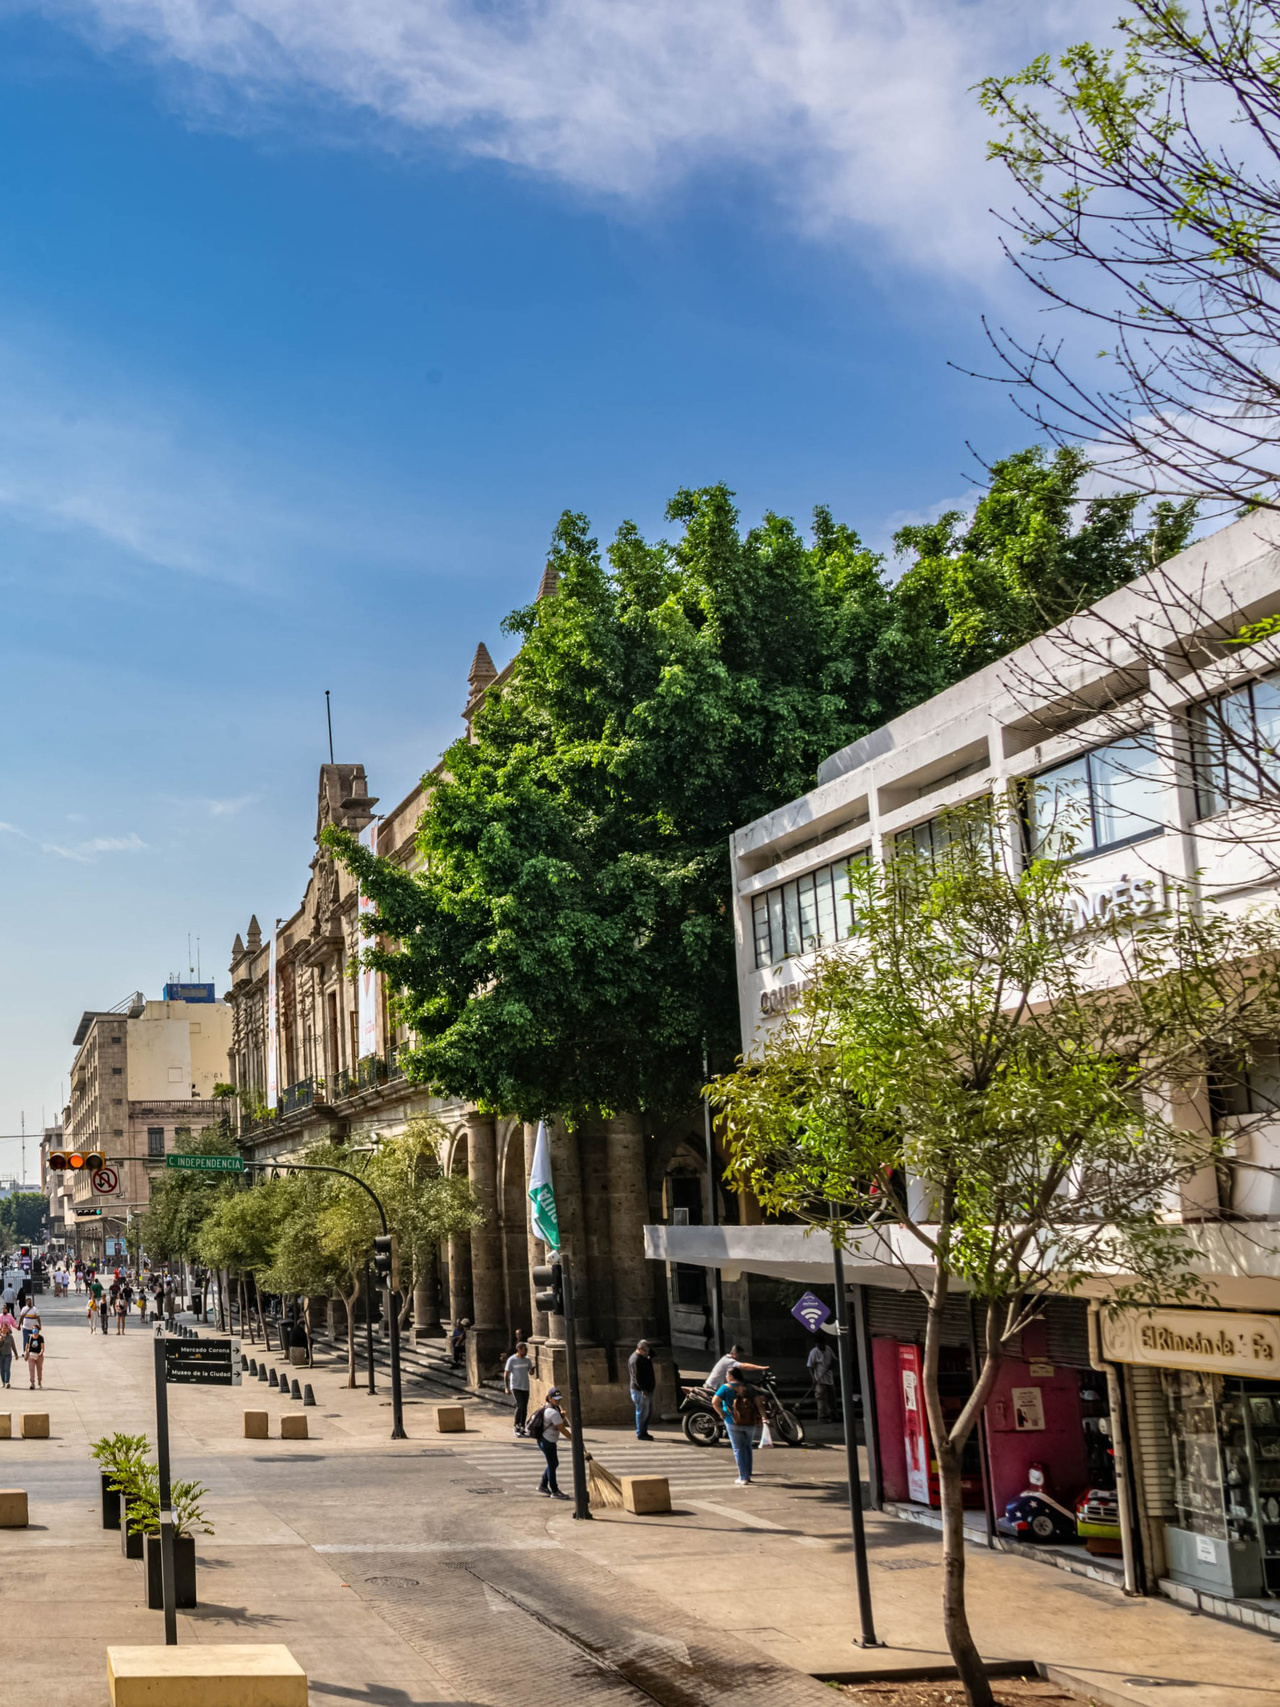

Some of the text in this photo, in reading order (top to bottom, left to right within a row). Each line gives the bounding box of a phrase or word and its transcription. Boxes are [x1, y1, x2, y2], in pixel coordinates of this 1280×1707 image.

[169, 1157, 240, 1169] C. INDEPENDENCIA
[1142, 1326, 1157, 1349] El
[1158, 1327, 1214, 1355] Rincón
[1216, 1330, 1235, 1356] de
